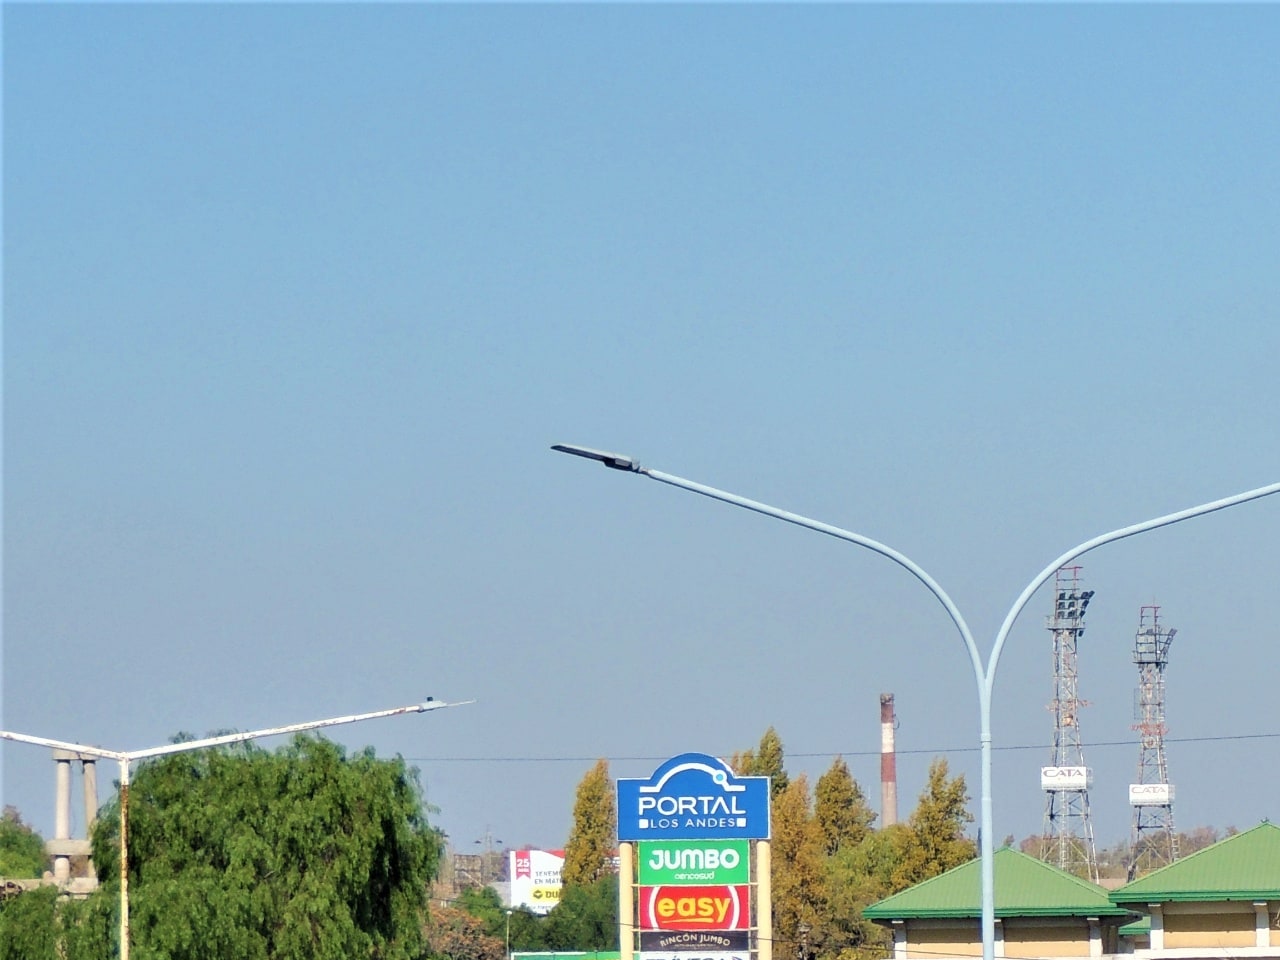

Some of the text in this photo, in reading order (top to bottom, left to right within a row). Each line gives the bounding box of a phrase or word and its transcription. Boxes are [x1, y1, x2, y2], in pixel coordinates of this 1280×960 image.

[1043, 769, 1083, 778] CATA
[1131, 786, 1166, 794] CATA
[638, 796, 746, 815] PORTAL
[651, 818, 735, 828] LOS ANDES
[516, 858, 530, 868] 25
[649, 848, 740, 870] JUMBO
[545, 891, 561, 899] DU
[657, 897, 731, 922] easy
[700, 934, 731, 946] JUMBO
